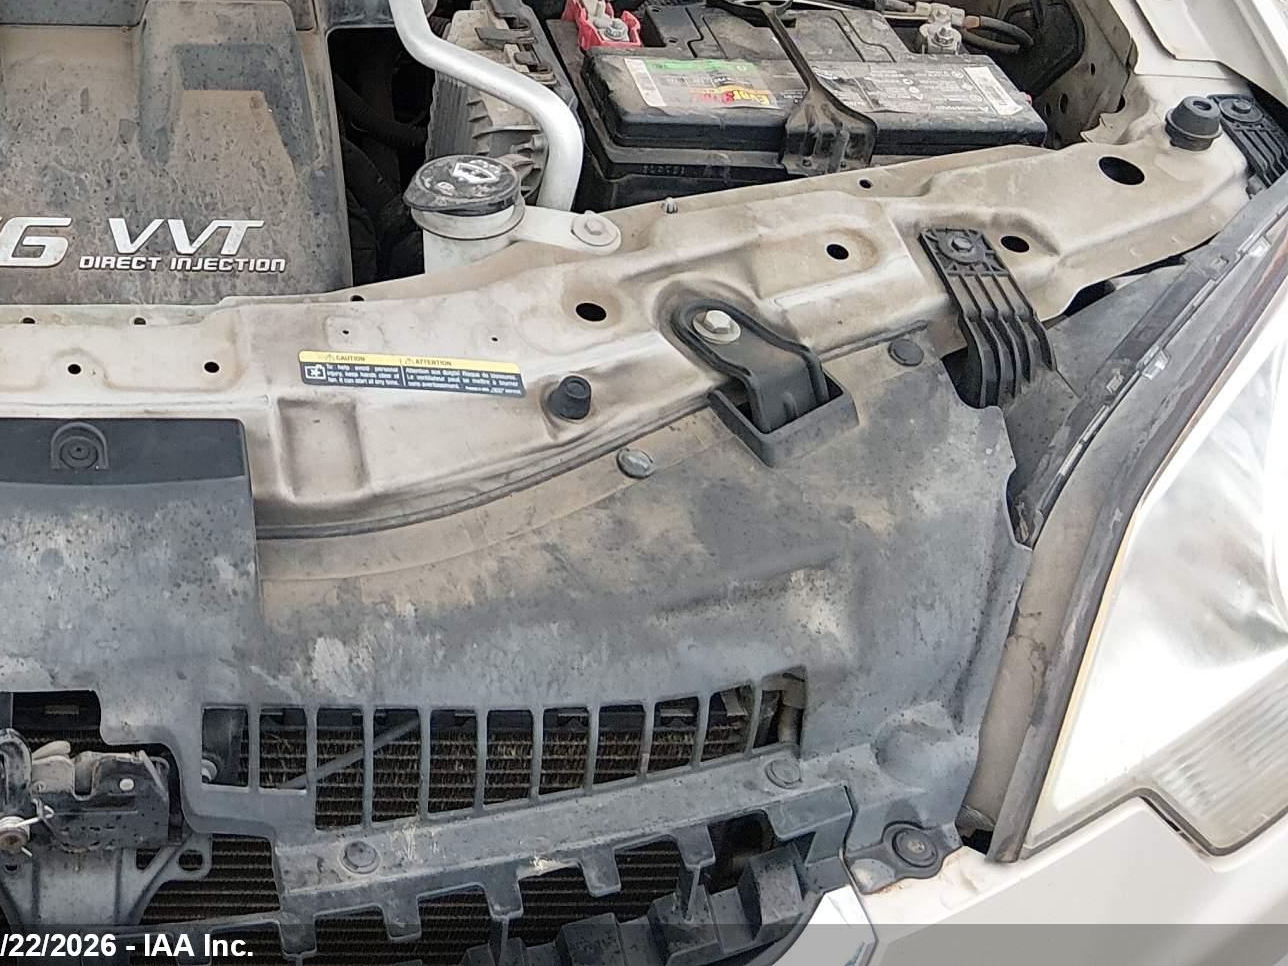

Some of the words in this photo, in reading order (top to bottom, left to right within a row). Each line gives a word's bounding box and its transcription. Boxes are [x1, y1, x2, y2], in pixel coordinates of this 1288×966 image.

[108, 218, 265, 256] VVT
[79, 256, 162, 271] DIRECT
[169, 257, 286, 272] INJECTION
